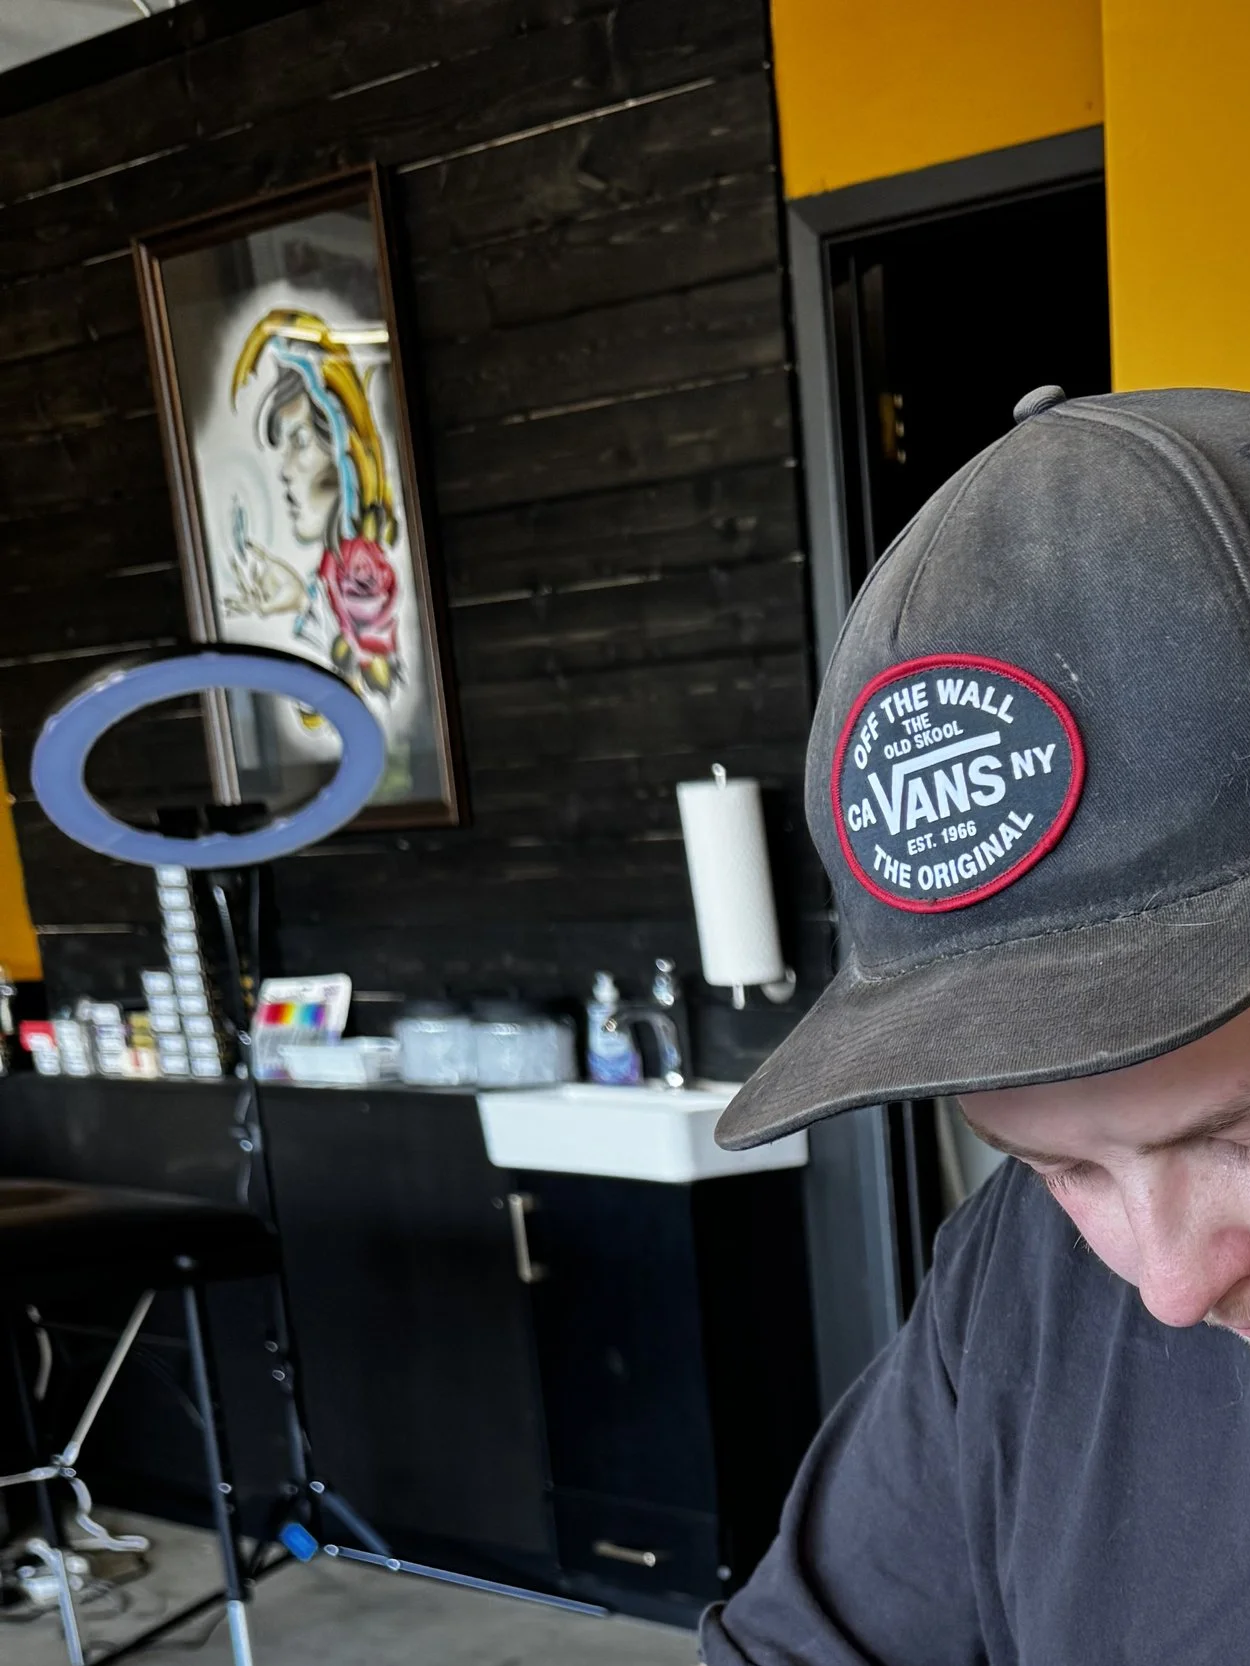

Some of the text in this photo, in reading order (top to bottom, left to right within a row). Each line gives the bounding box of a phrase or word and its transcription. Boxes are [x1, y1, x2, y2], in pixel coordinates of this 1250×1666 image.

[854, 678, 1015, 770] OFF THE WALL
[884, 720, 963, 760] OLD SKOOL
[902, 712, 931, 735] THE
[848, 731, 1056, 835] CA VANS NY
[873, 810, 1034, 891] THE ORIGINAL
[907, 820, 977, 856] EST. 1966
